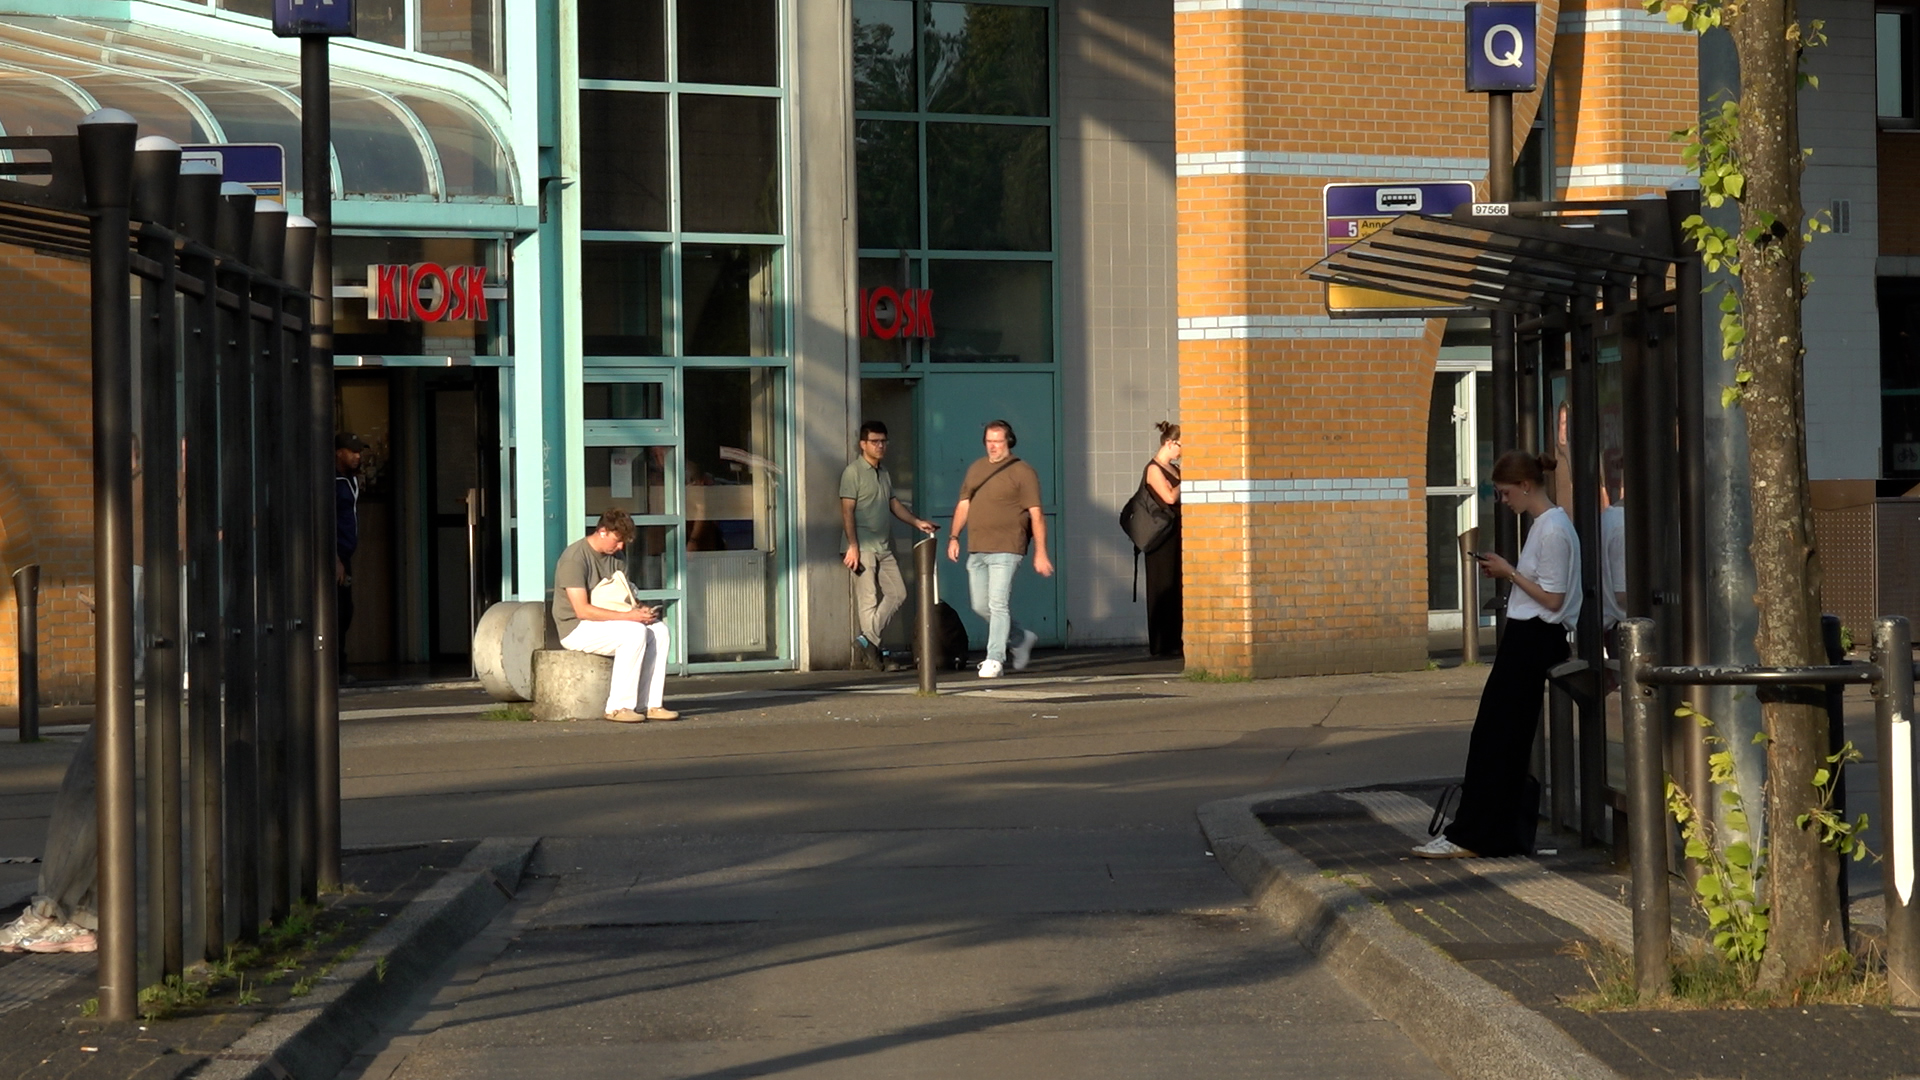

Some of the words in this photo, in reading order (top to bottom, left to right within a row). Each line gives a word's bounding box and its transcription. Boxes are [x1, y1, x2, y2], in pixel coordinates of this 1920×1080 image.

[1484, 24, 1523, 68] Q
[1348, 221, 1358, 237] 5
[1475, 205, 1507, 215] 97566
[376, 262, 489, 322] KIOSK
[860, 286, 935, 340] IOSK
